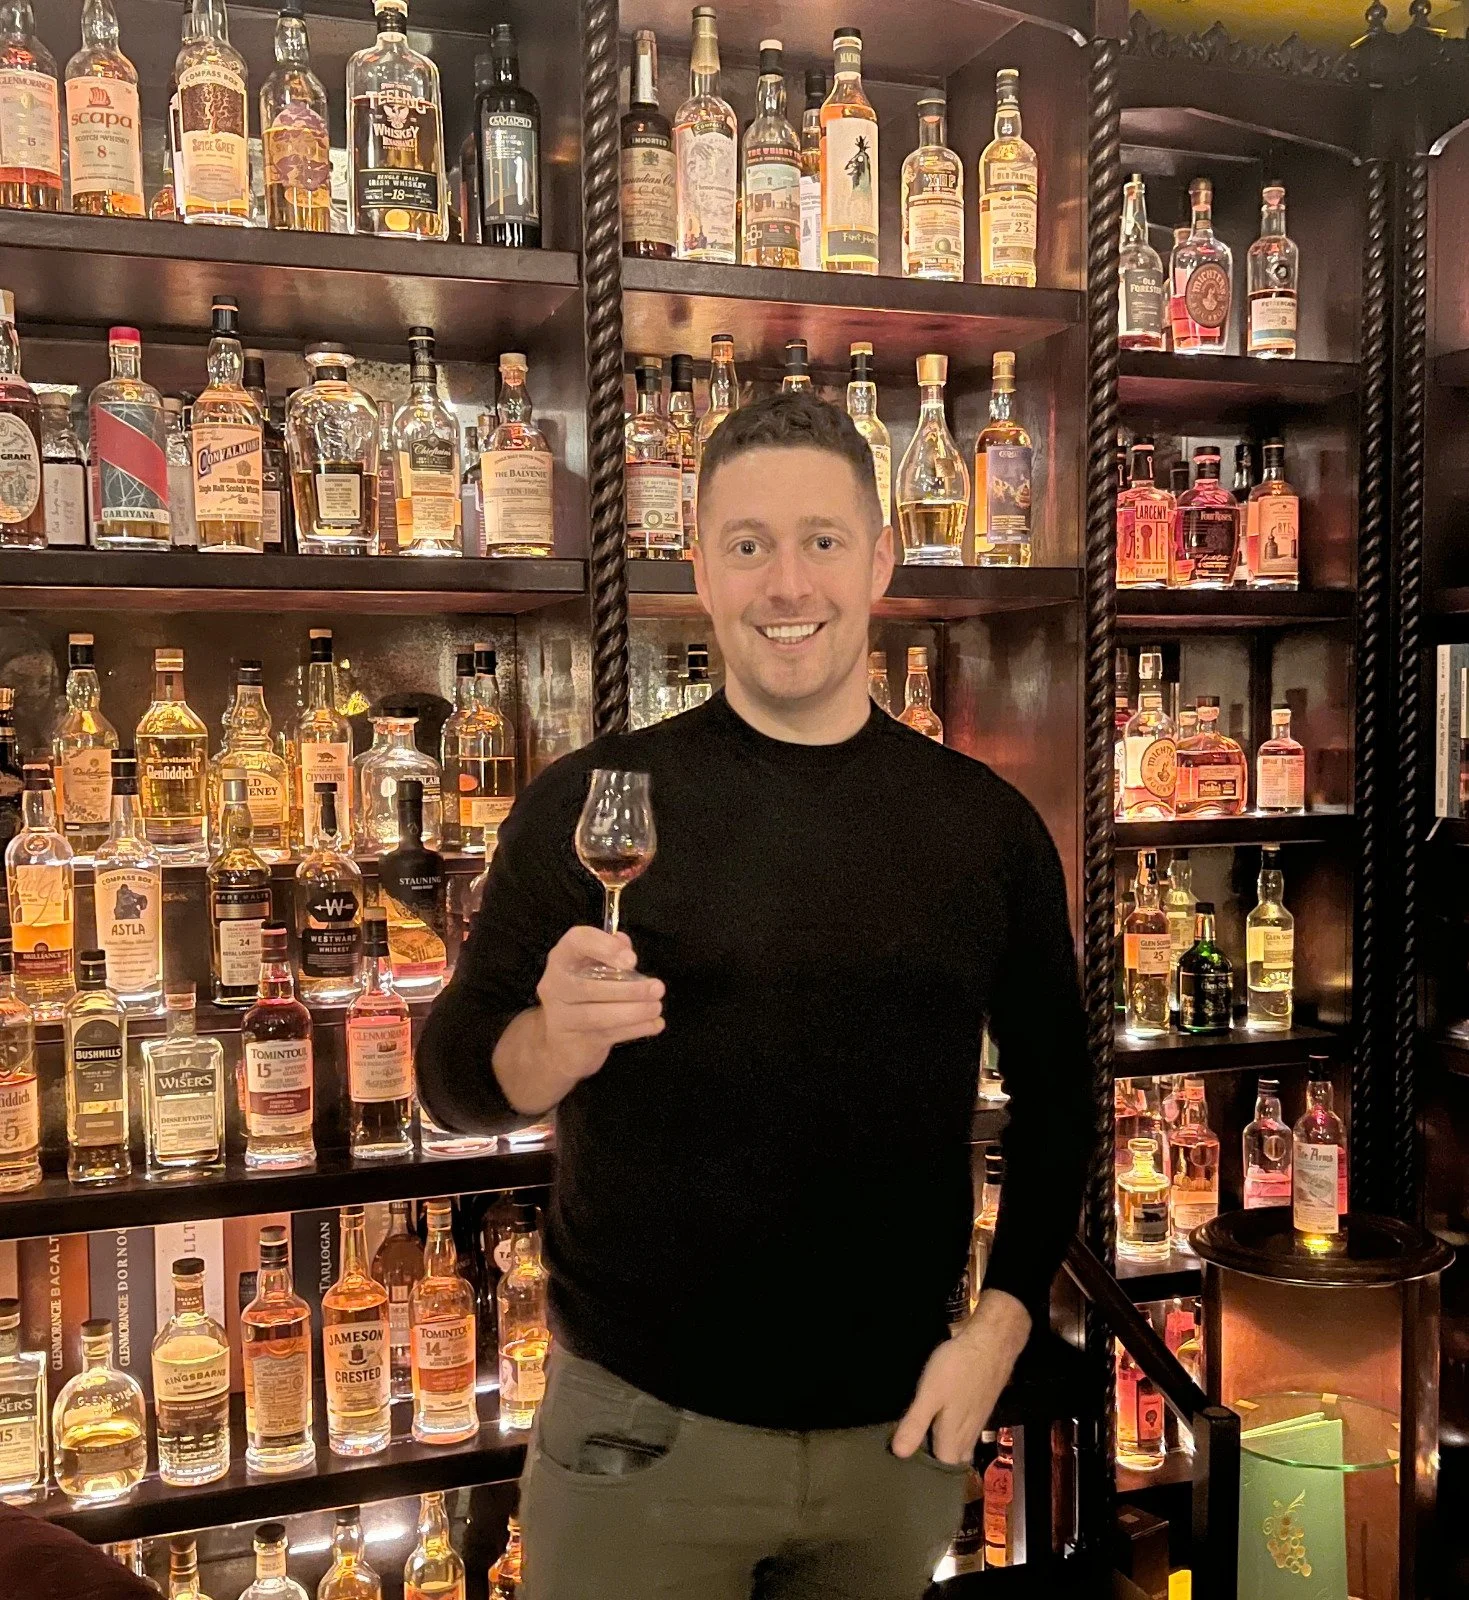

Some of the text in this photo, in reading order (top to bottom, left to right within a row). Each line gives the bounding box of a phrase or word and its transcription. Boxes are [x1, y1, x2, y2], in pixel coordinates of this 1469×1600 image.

[185, 69, 239, 87] COMPASS BOX
[366, 89, 428, 115] TEELING
[72, 111, 132, 129] scapa
[373, 123, 420, 139] WHISKEY
[632, 136, 668, 148] IMPORTED
[98, 145, 107, 158] 8
[369, 179, 428, 189] IRISH WHISKEY
[623, 172, 662, 185] anadian
[391, 188, 406, 200] 18
[1015, 221, 1029, 236] 25
[1142, 277, 1156, 286] OLD
[495, 469, 548, 479] THE BALVENIE
[505, 488, 521, 496] TUN
[104, 510, 156, 520] GARRYANA
[1135, 504, 1167, 521] LARCENY
[1277, 522, 1292, 533] RYE
[147, 764, 195, 785] Glenfiddich
[101, 875, 152, 886] COMPASS BOX
[399, 876, 442, 886] STAUNING
[215, 892, 269, 902] RARE MALTS
[111, 923, 146, 936] ASYLA
[239, 938, 251, 947] 24
[311, 934, 358, 943] WESTWARD
[1140, 939, 1155, 947] GLEN
[1265, 933, 1281, 942] GLEN
[22, 952, 62, 960] BRILLIANCE
[1153, 950, 1164, 962] 25
[75, 1047, 122, 1060] BUSHMILLS
[250, 1046, 308, 1061] TOMINTOUL
[256, 1062, 270, 1079] 15
[93, 1082, 104, 1093] 21
[158, 1074, 213, 1090] WISER'S
[160, 1113, 213, 1124] DISSERTATION
[1309, 1147, 1334, 1164] Arms
[319, 1220, 334, 1294] TARLOGAN
[50, 1299, 64, 1371] GLENMORANGIE
[117, 1293, 131, 1367] GLENMORANGIE
[328, 1329, 384, 1346] JAMESON
[424, 1341, 442, 1357] 14
[164, 1369, 227, 1386] KINGSBARNS
[334, 1366, 381, 1384] CRESTED
[0, 1397, 33, 1414] SER'S
[0, 1428, 14, 1443] 15
